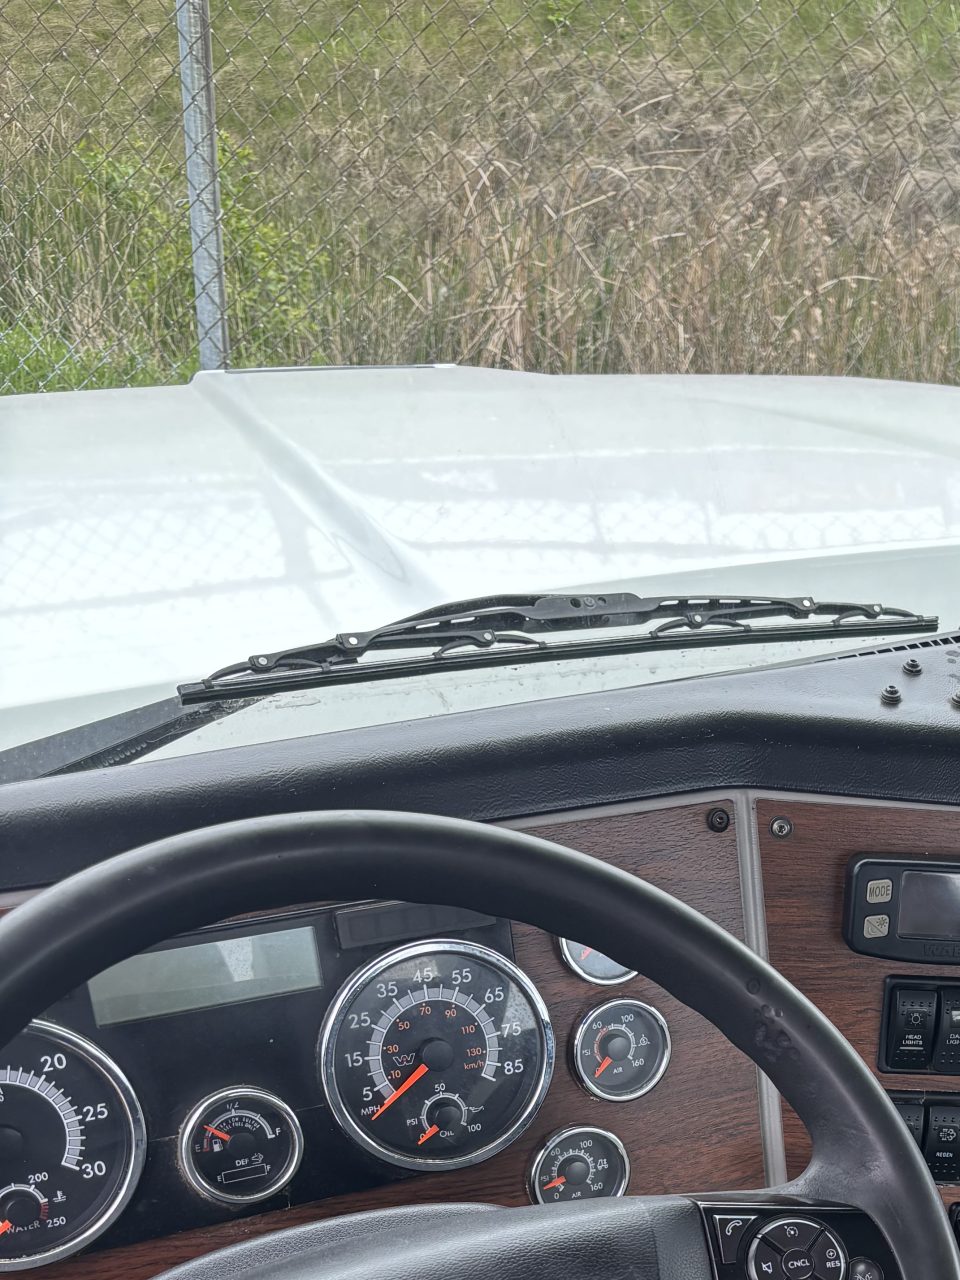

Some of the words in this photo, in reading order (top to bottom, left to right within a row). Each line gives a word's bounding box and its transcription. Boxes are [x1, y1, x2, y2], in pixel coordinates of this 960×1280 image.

[869, 883, 890, 899] MODE
[413, 968, 433, 983] 45
[451, 968, 472, 984] 55
[376, 982, 398, 998] 35
[484, 987, 504, 1003] 65
[419, 1007, 431, 1016] 70
[445, 1009, 457, 1018] 90
[349, 1012, 371, 1029] 25
[621, 1013, 634, 1023] 100
[398, 1021, 410, 1030] 50
[461, 1025, 476, 1034] 110
[501, 1022, 522, 1038] 75
[592, 1021, 602, 1030] 60
[387, 1045, 399, 1054] 30
[466, 1047, 482, 1056] 130
[40, 1053, 67, 1073] 20
[345, 1052, 363, 1067] 15
[632, 1059, 645, 1067] 160
[464, 1061, 484, 1070] km/h
[504, 1059, 524, 1075] 85
[391, 1070, 401, 1078] 10
[434, 1083, 446, 1092] 50
[362, 1086, 373, 1101] 5
[83, 1103, 108, 1122] 25
[361, 1105, 380, 1116] MPH
[407, 1119, 418, 1127] PSI
[467, 1123, 482, 1133] 100
[276, 1128, 281, 1136] F
[580, 1140, 593, 1148] 100
[551, 1148, 560, 1156] 60
[235, 1158, 249, 1166] DEF
[81, 1160, 106, 1178] 30
[28, 1172, 49, 1184] 200
[591, 1182, 603, 1191] 160
[46, 1216, 66, 1228] 250
[6, 1221, 41, 1235] WATER
[788, 1259, 810, 1269] CNCL
[826, 1260, 841, 1269] RES
